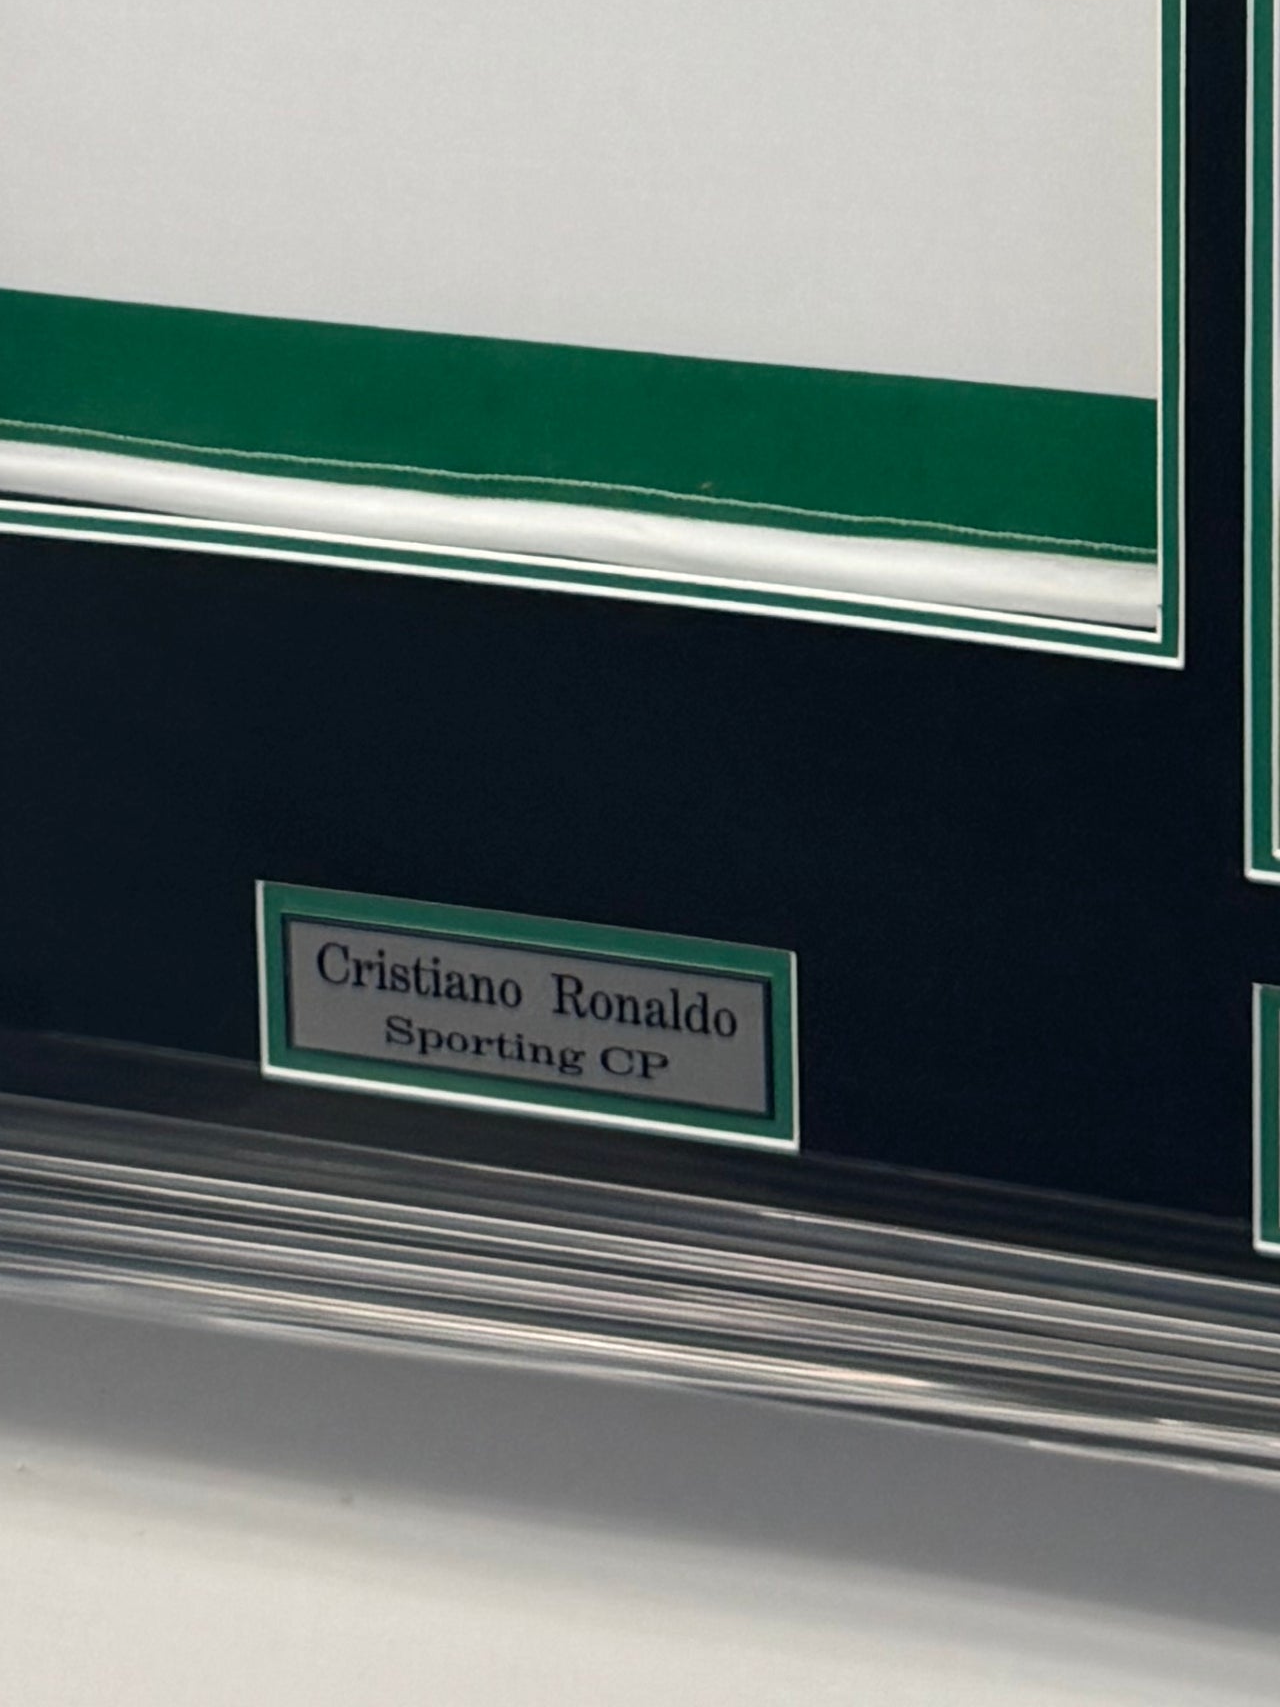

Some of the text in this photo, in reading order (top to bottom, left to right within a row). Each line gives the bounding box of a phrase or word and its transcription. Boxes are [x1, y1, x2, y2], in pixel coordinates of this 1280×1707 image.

[316, 942, 738, 1038] Cristiano Ronaldo
[385, 1016, 670, 1080] Sporting CP
